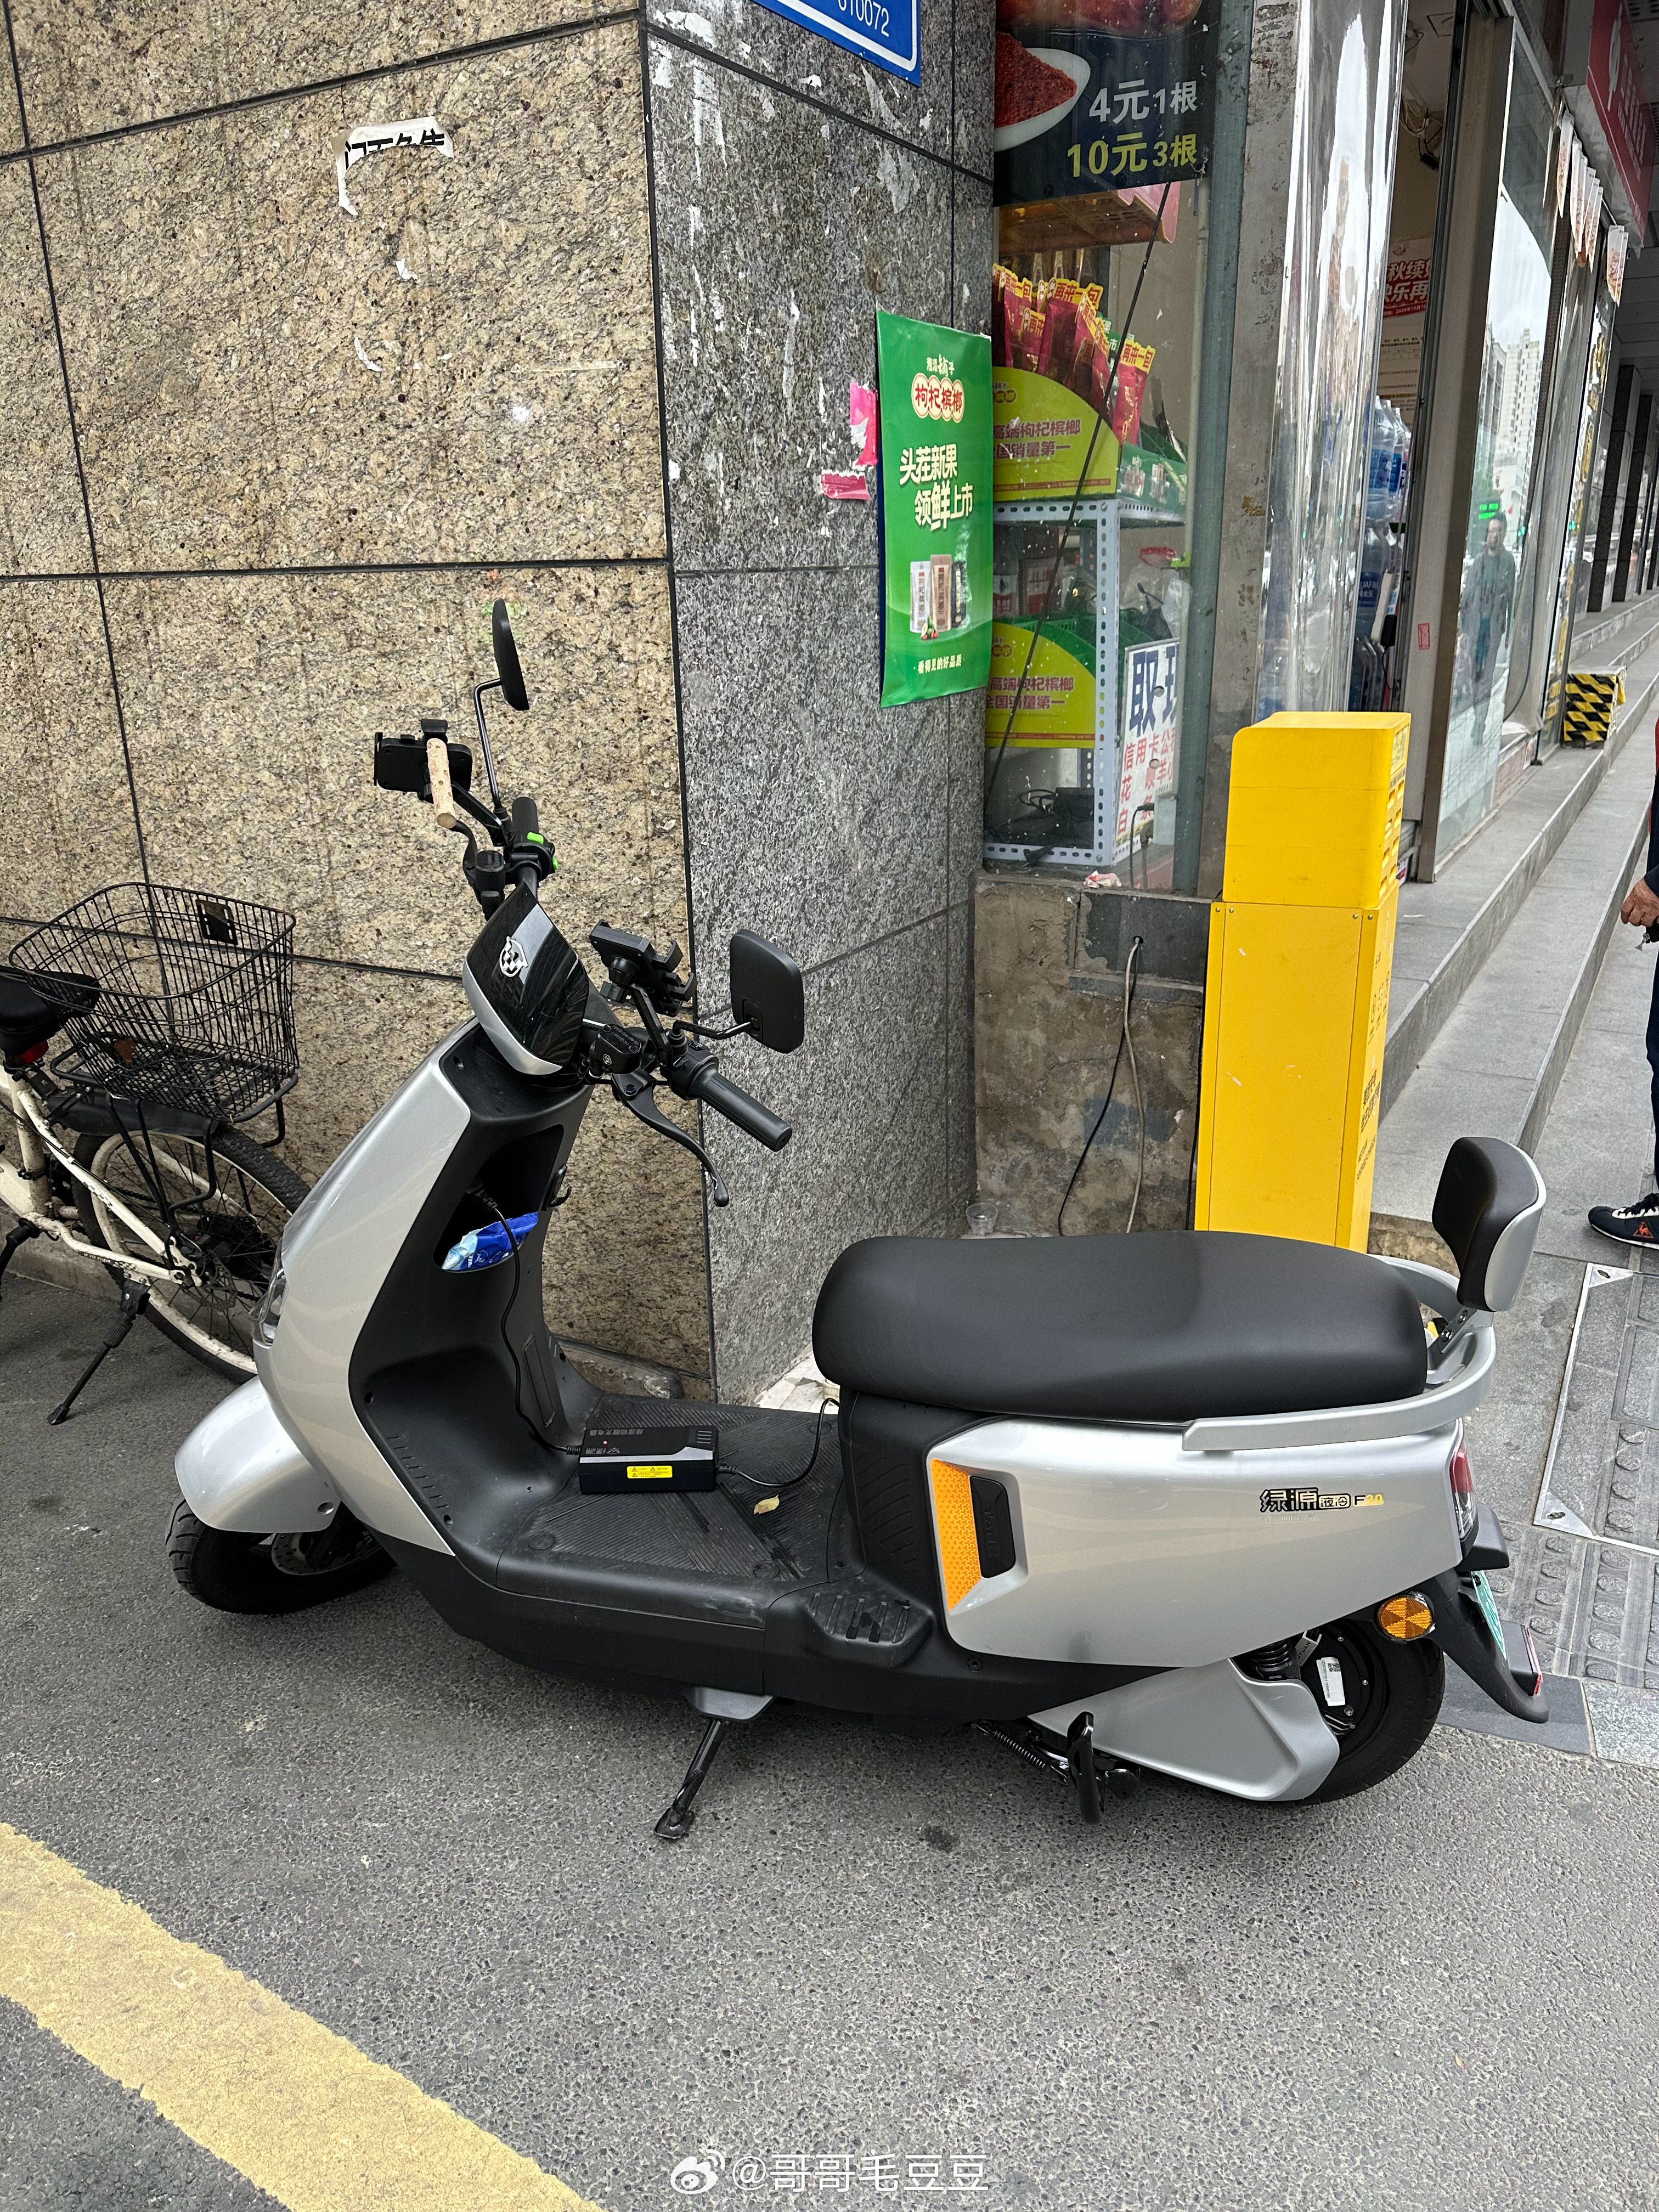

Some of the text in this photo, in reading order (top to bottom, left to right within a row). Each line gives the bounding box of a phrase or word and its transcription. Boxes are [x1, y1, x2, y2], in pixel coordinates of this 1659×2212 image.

[1089, 79, 1198, 124] 4元1根
[1068, 132, 1197, 177] 10元3根
[1387, 258, 1431, 282] 秋续
[1053, 282, 1101, 306] 再来一包
[915, 382, 962, 413] 枸杞槟榔
[993, 419, 1081, 439] 高端枸杞槟榔
[994, 441, 1071, 459] 国销量第一
[899, 443, 958, 485] 头茬新果
[914, 479, 973, 531] 领鲜上市
[990, 676, 1074, 692] 高端枸杞槟榔
[1260, 1488, 1383, 1512] 绿源 液冷 F20
